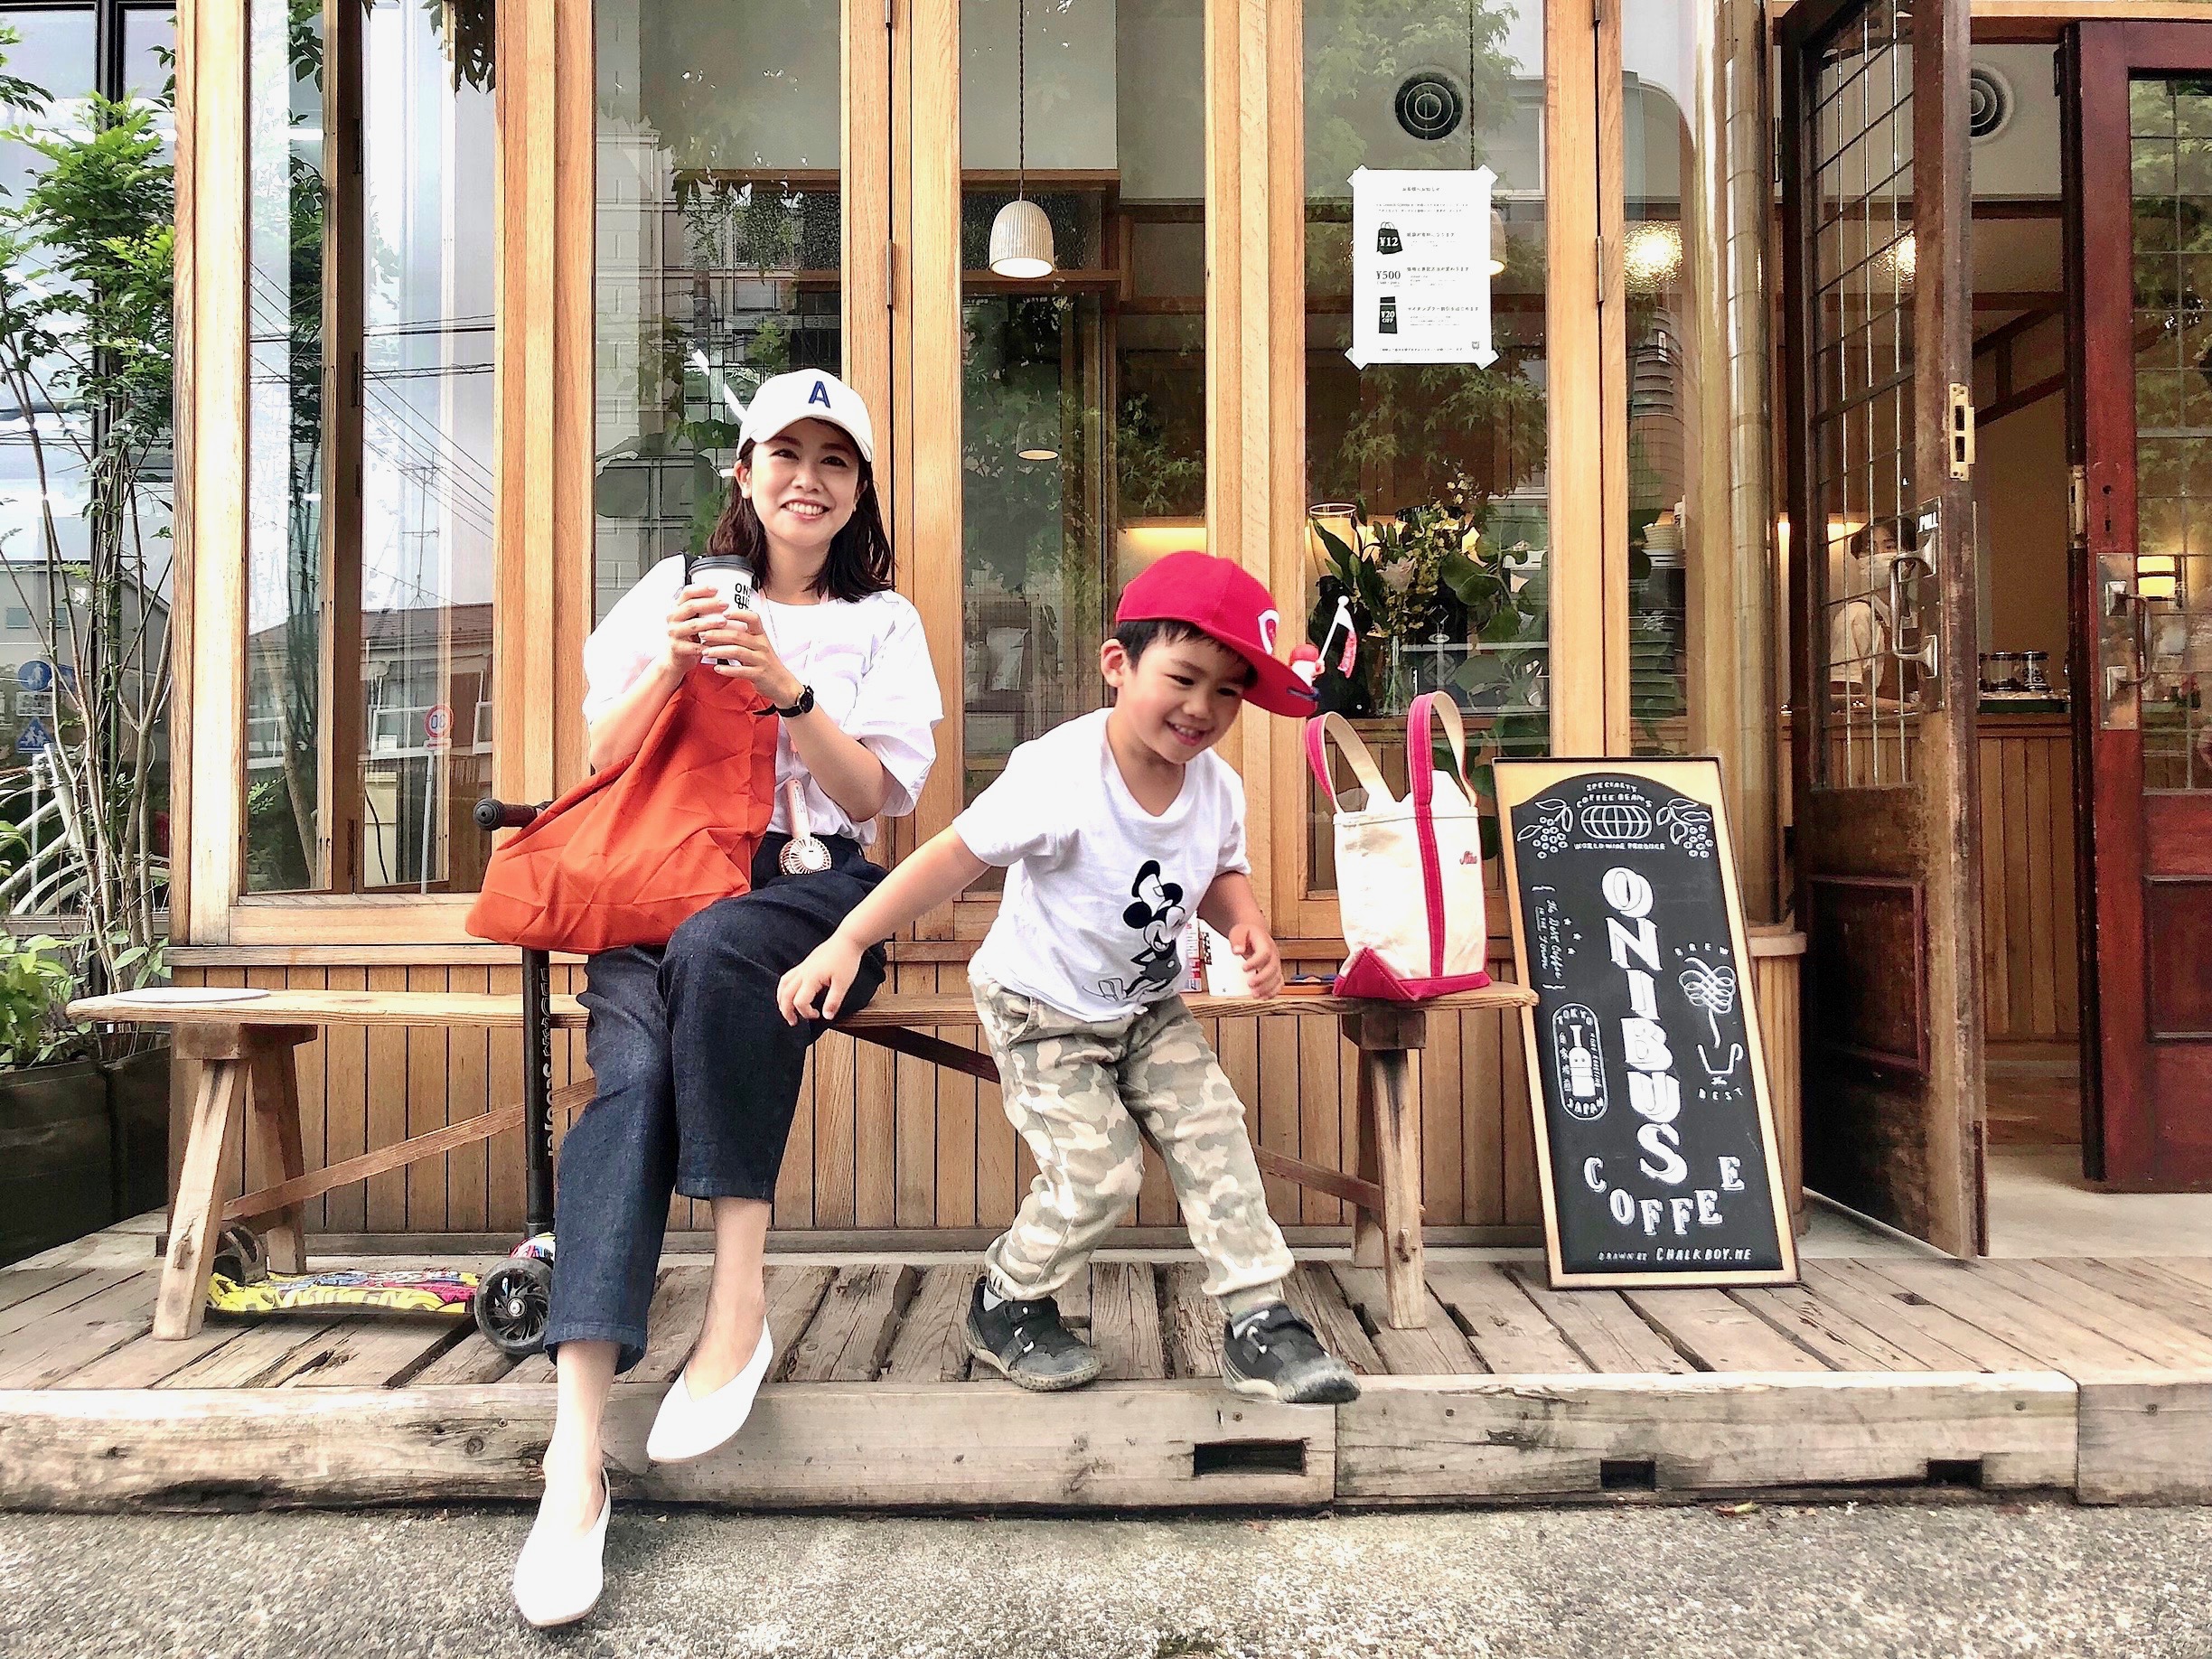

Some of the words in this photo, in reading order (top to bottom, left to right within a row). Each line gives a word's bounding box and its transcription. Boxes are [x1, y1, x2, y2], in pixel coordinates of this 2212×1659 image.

[1379, 237, 1399, 247] ¥12
[1376, 270, 1401, 279] ¥500
[809, 380, 830, 408] A
[1586, 782, 1637, 792] SPECIALTY
[1576, 793, 1616, 808] COFFEE
[1674, 942, 1729, 957] BREW
[1556, 1008, 1593, 1026] TOKYO
[1602, 867, 1688, 1186] ONIBUS
[1698, 1086, 1743, 1101] BEST
[1566, 1097, 1604, 1115] JAPAN
[1583, 1156, 1745, 1236] COFFEE
